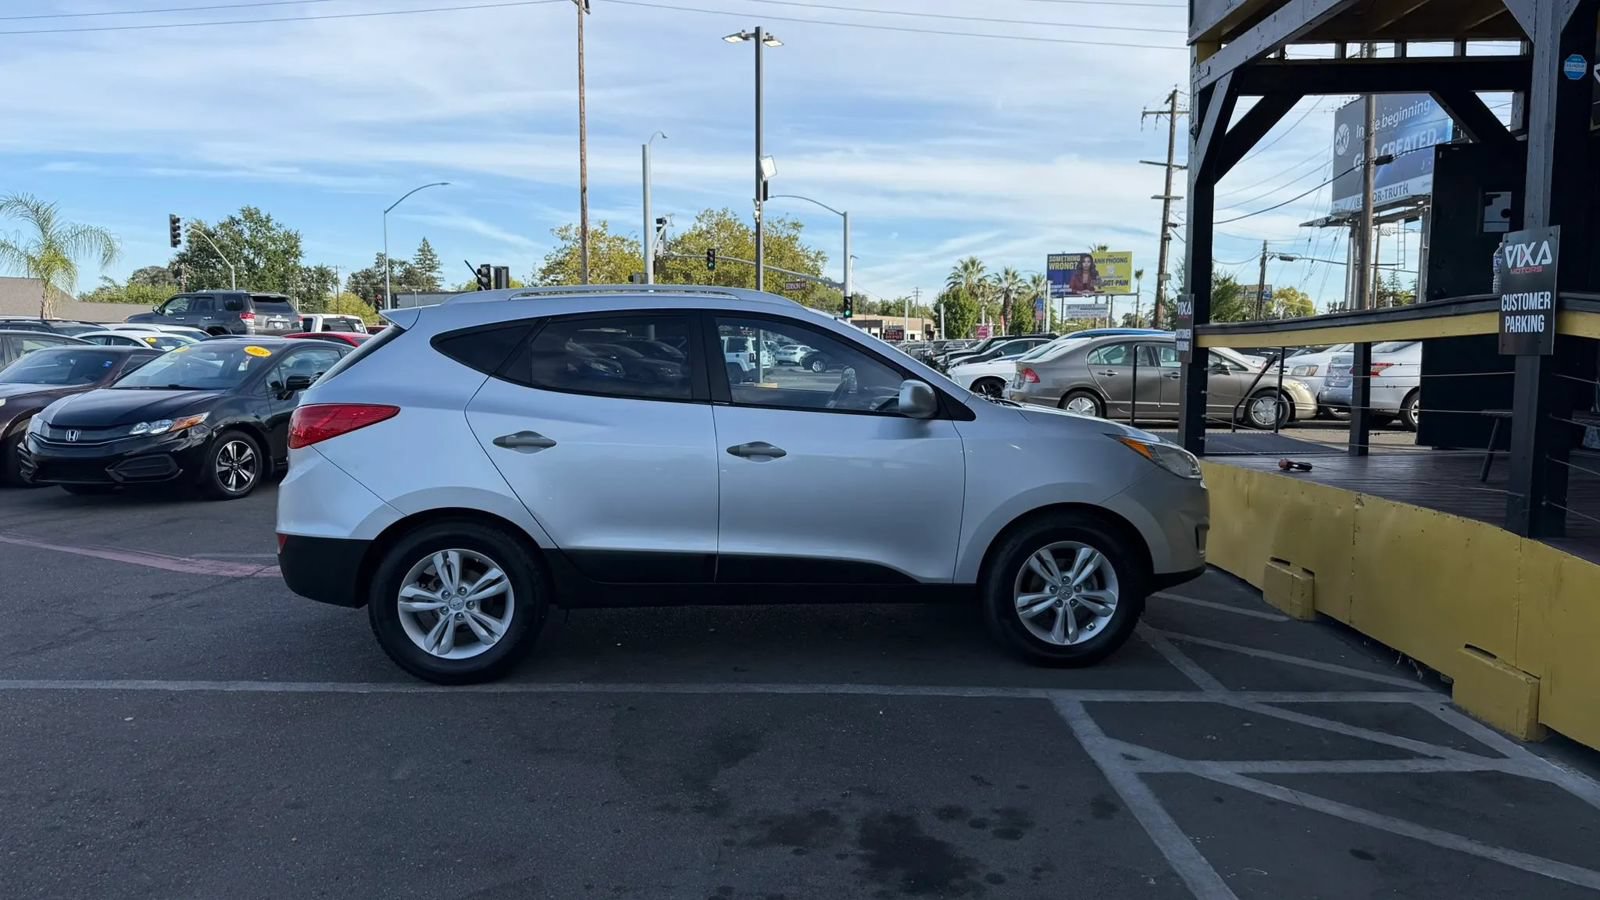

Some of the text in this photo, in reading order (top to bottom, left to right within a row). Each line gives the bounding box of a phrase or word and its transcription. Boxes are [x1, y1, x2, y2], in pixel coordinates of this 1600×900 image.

[1356, 124, 1365, 139] In
[1381, 100, 1431, 128] beginning
[1504, 240, 1553, 268] VIXA
[1048, 262, 1079, 271] WRONG?
[1501, 291, 1552, 311] CUSTOMER
[1505, 314, 1545, 333] PARKING
